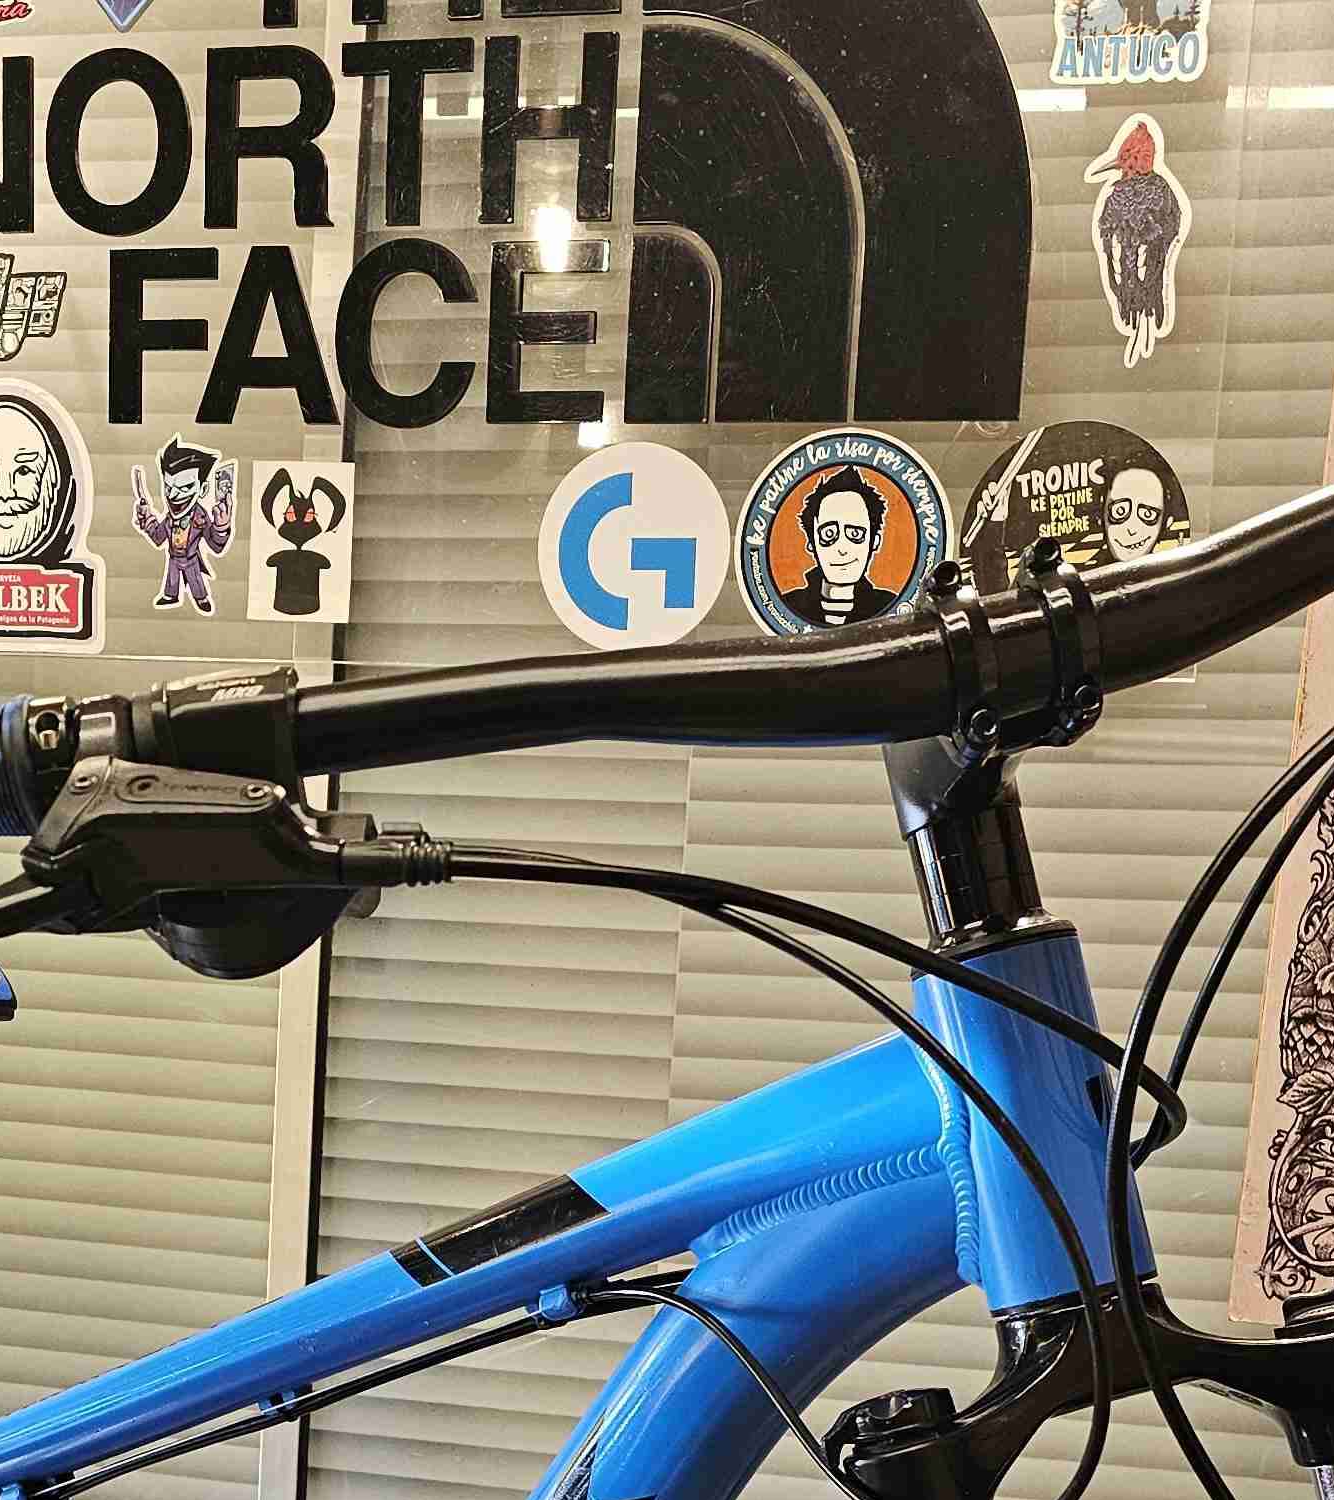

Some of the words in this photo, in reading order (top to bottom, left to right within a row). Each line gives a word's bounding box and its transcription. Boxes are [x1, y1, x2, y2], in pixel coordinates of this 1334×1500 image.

[1057, 31, 1200, 78] ANTUCO
[108, 236, 611, 431] FACE
[806, 443, 831, 465] la
[873, 446, 907, 470] por
[1016, 458, 1105, 498] TRONIC
[1030, 496, 1047, 513] KE
[1049, 487, 1093, 509] PATINE
[1050, 504, 1075, 521] POR
[1038, 516, 1090, 538] SIEMPRE
